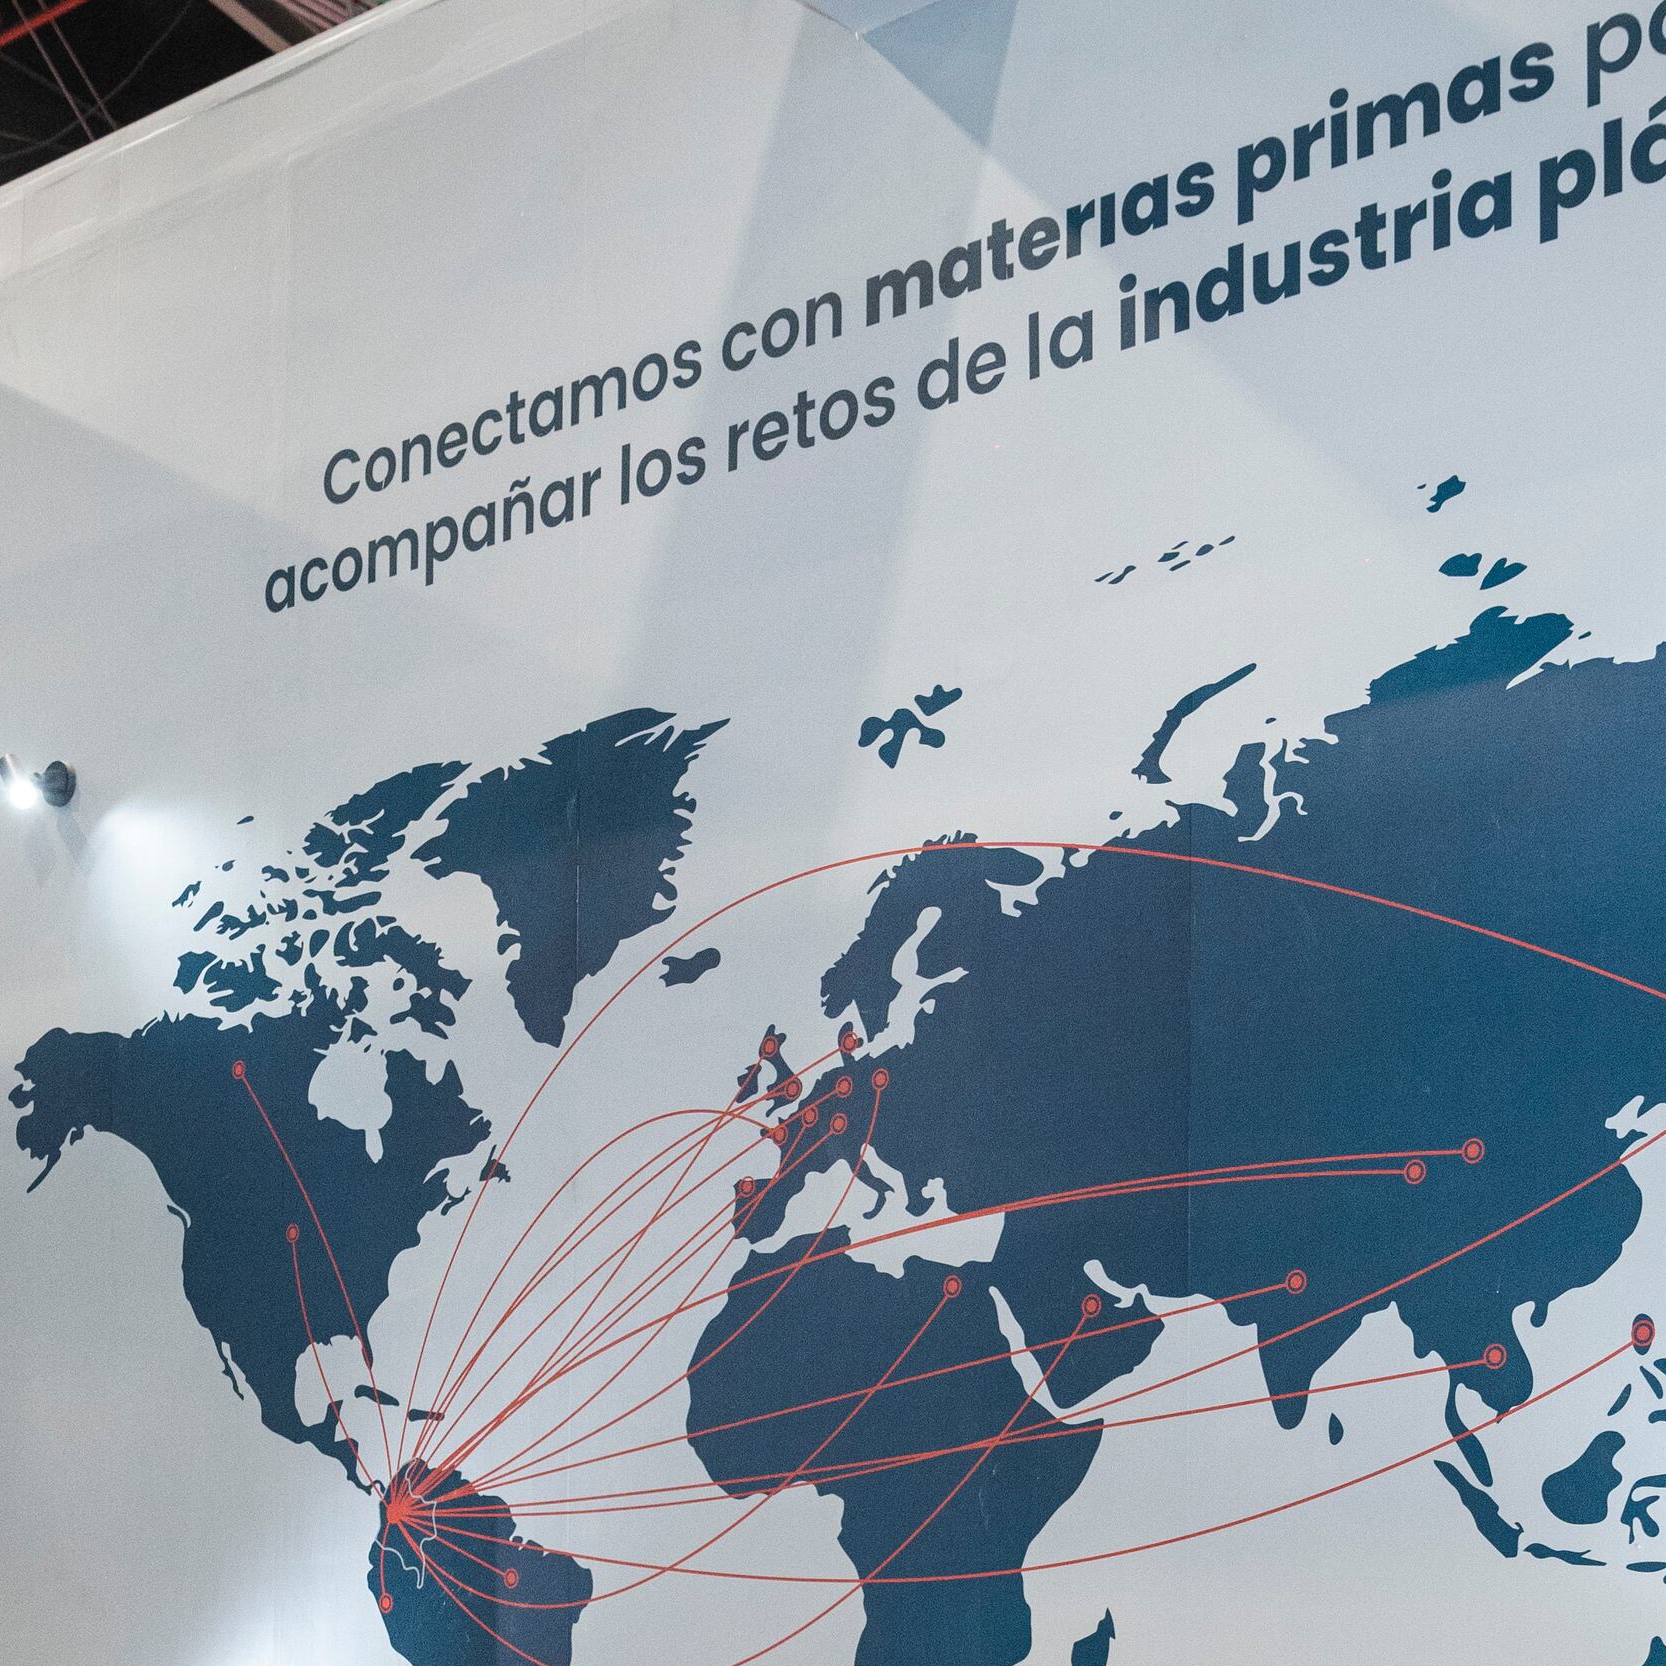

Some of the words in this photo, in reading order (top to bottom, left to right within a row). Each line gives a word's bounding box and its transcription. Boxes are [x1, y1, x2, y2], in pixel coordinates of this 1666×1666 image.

[263, 464, 603, 615] acompañar
[619, 435, 708, 506] los
[726, 375, 897, 473] retos
[916, 336, 1008, 411] de
[1027, 309, 1095, 381] la
[1118, 170, 1514, 352] industria
[322, 338, 703, 506] Conectamos
[720, 290, 844, 373] con
[1235, 40, 1556, 227] primas
